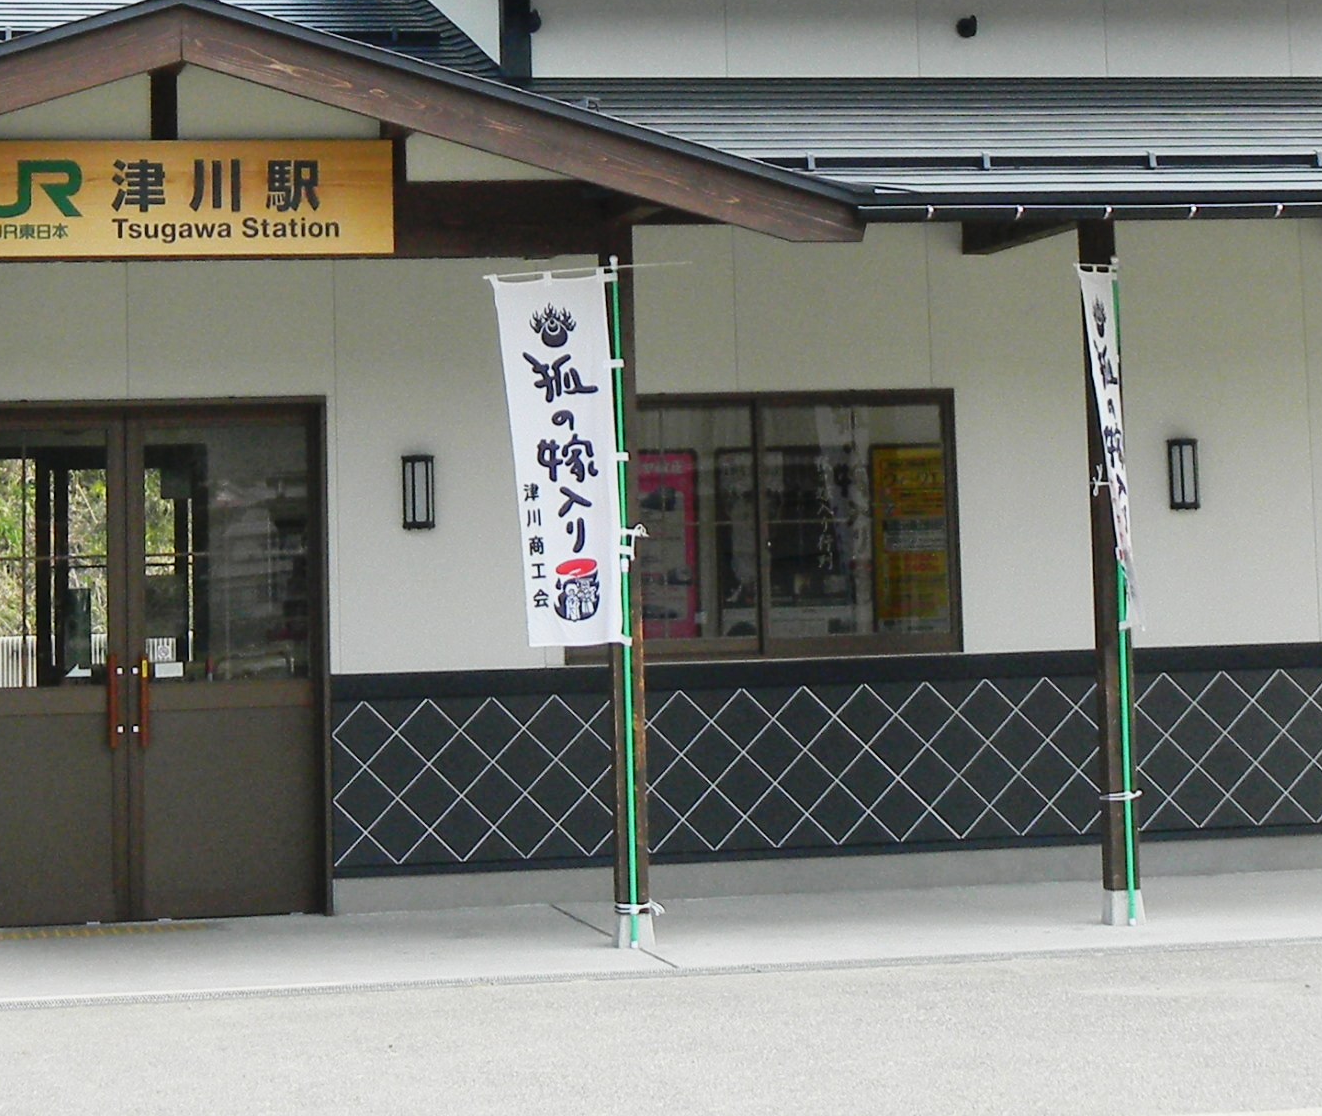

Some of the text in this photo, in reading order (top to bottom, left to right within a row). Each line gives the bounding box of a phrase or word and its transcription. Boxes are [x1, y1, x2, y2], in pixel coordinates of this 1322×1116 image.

[110, 159, 320, 214] 津川駅
[112, 217, 340, 243] Tsugawa Station
[523, 351, 599, 553] 狐の嫁入り
[523, 483, 550, 608] 津川商工会
